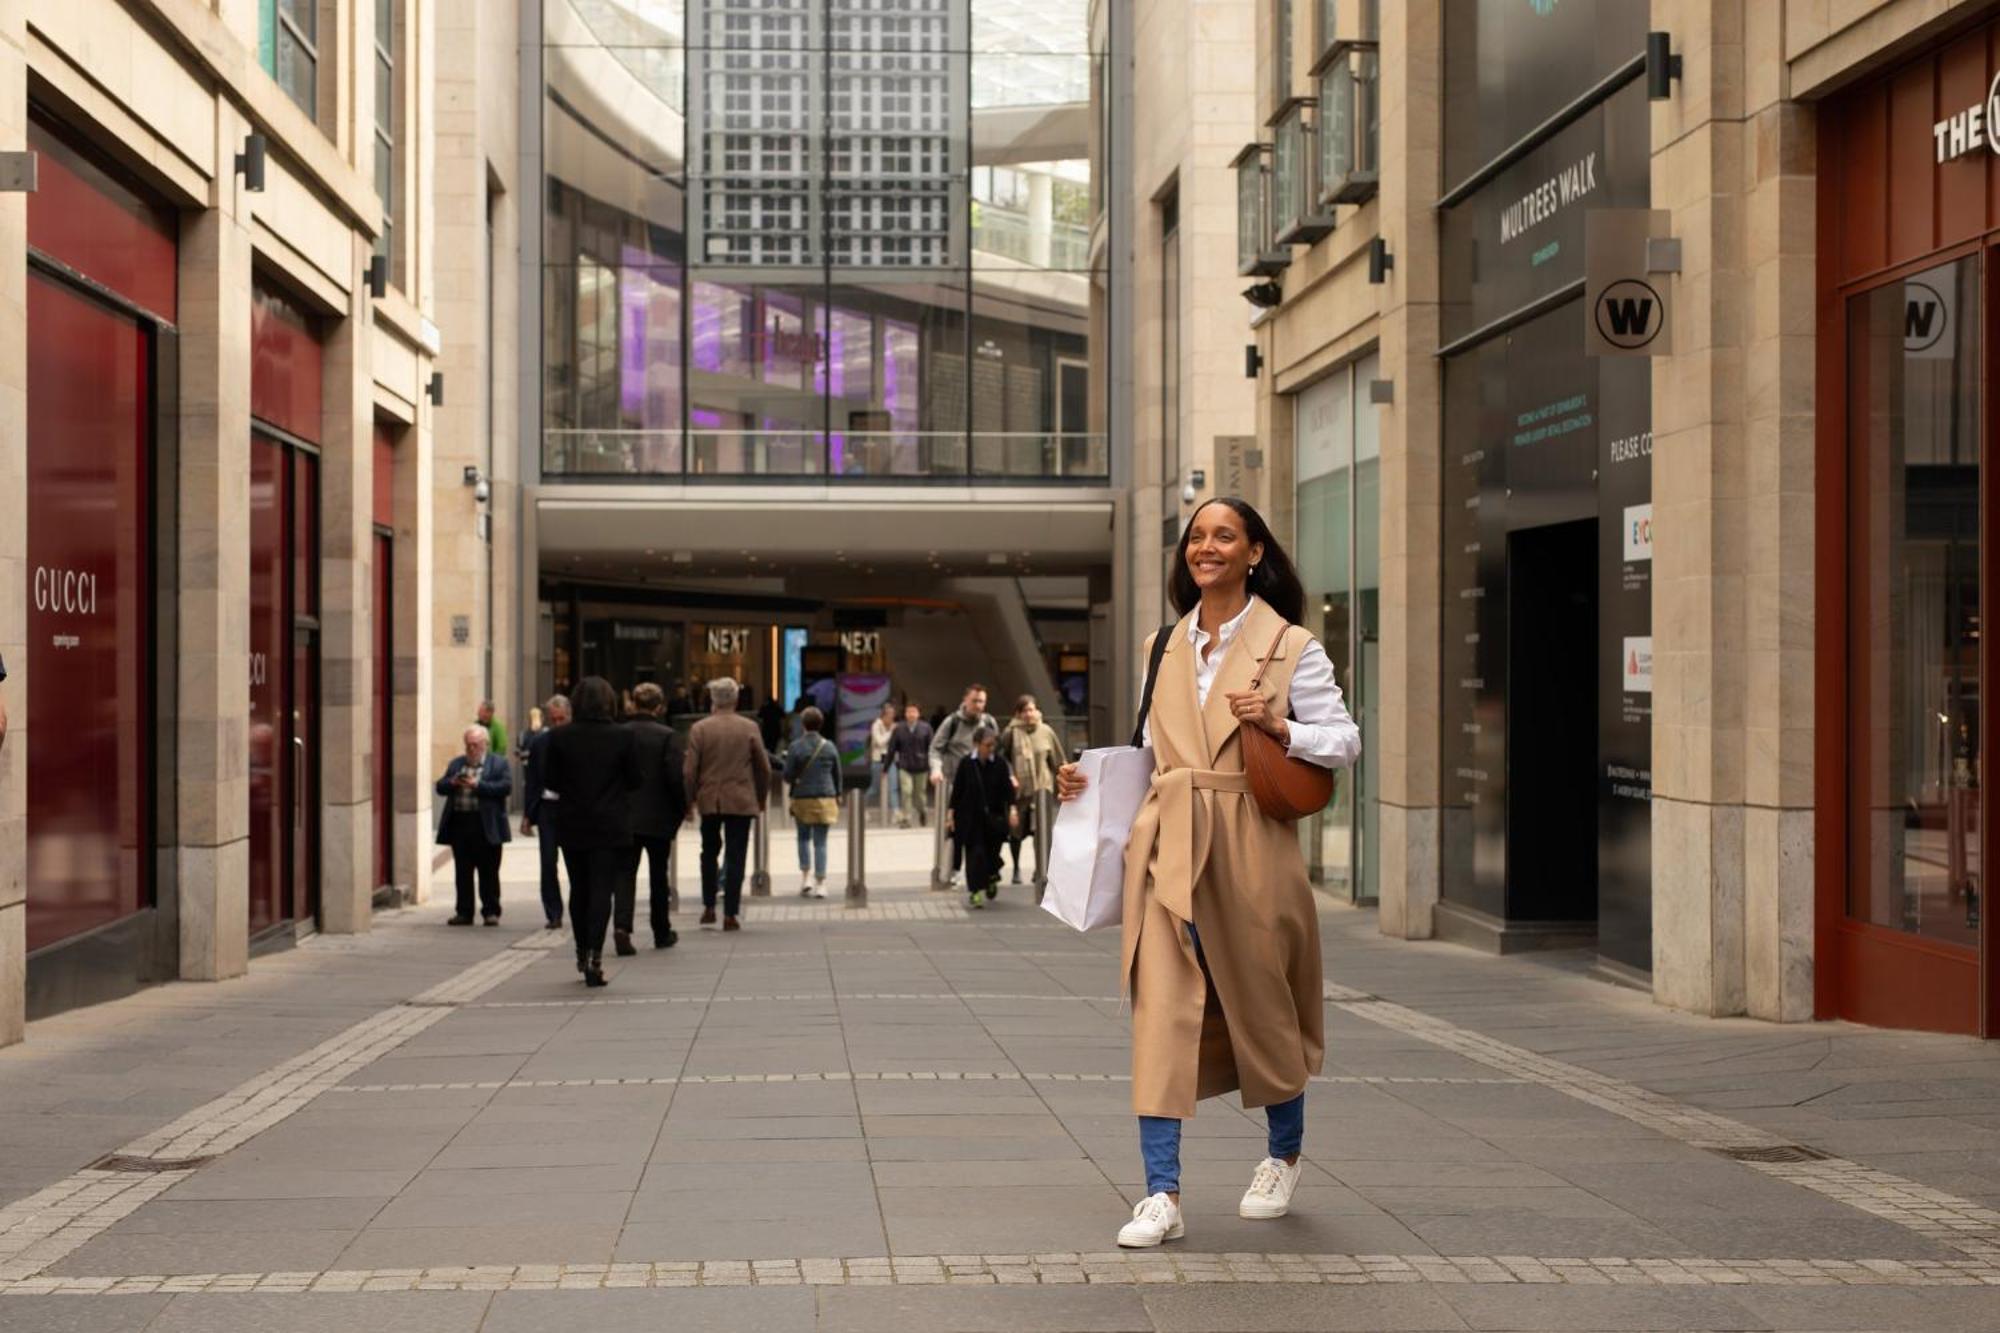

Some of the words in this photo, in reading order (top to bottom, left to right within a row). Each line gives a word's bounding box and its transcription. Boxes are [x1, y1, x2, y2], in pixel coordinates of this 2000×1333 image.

[1933, 103, 1983, 165] THE
[1501, 178, 1558, 245] MULTREES
[1559, 152, 1596, 207] WALK
[1606, 298, 1653, 335] W
[1611, 435, 1639, 463] PLEASE
[35, 565, 96, 614] GUCCI
[709, 629, 750, 656] NEXT
